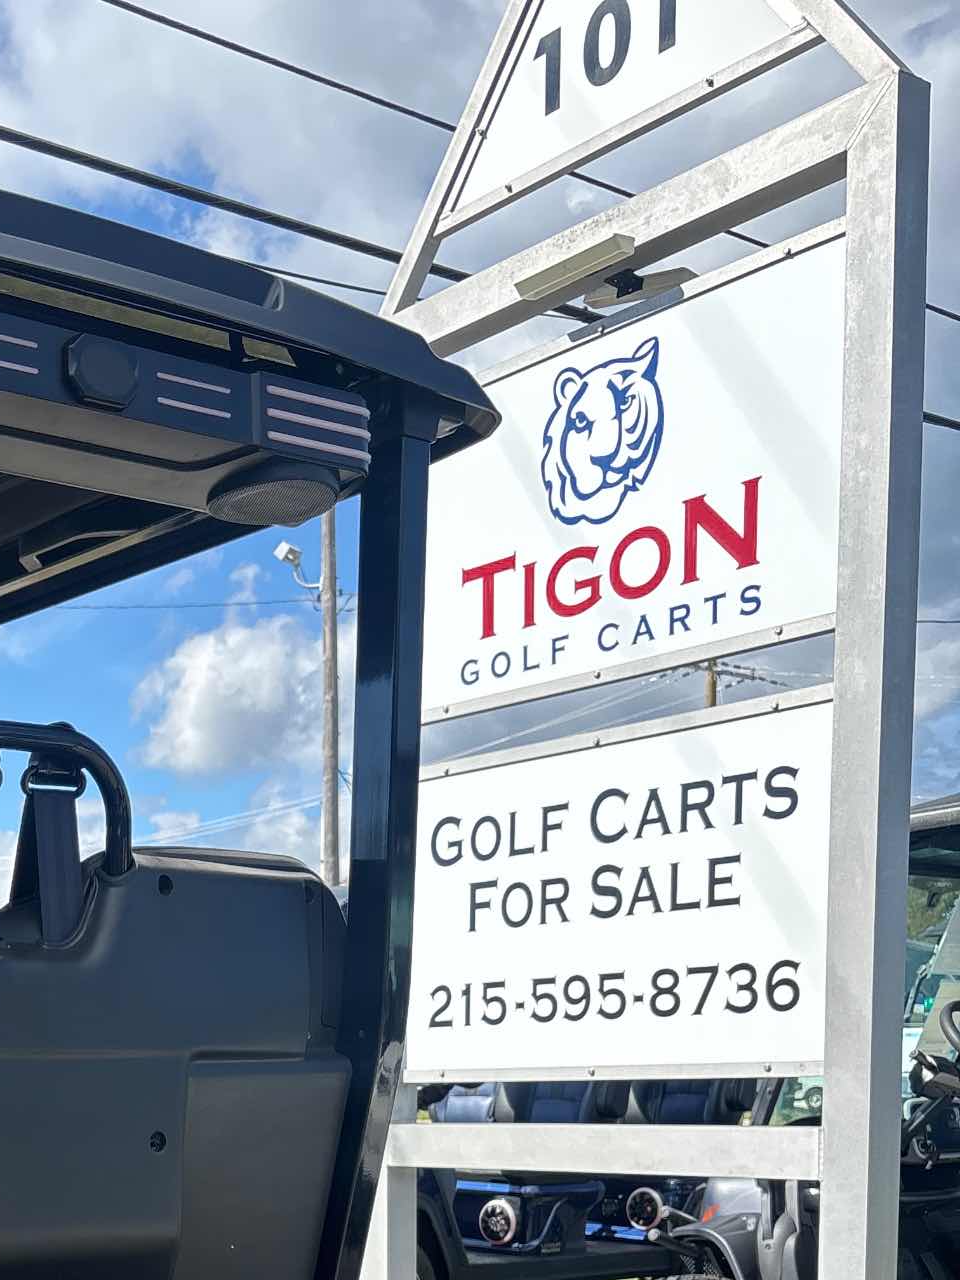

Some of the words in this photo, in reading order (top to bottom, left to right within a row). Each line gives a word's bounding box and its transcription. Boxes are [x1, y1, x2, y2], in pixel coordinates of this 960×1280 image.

[533, 0, 677, 117] 101
[461, 475, 763, 640] TIGON
[460, 634, 570, 686] GOLF
[597, 584, 762, 652] CARTS
[430, 801, 570, 867] GOLF
[589, 765, 801, 844] CARTS
[468, 877, 570, 932] FOR
[589, 853, 742, 919] SALE
[428, 959, 801, 1029] 215-595-8736
